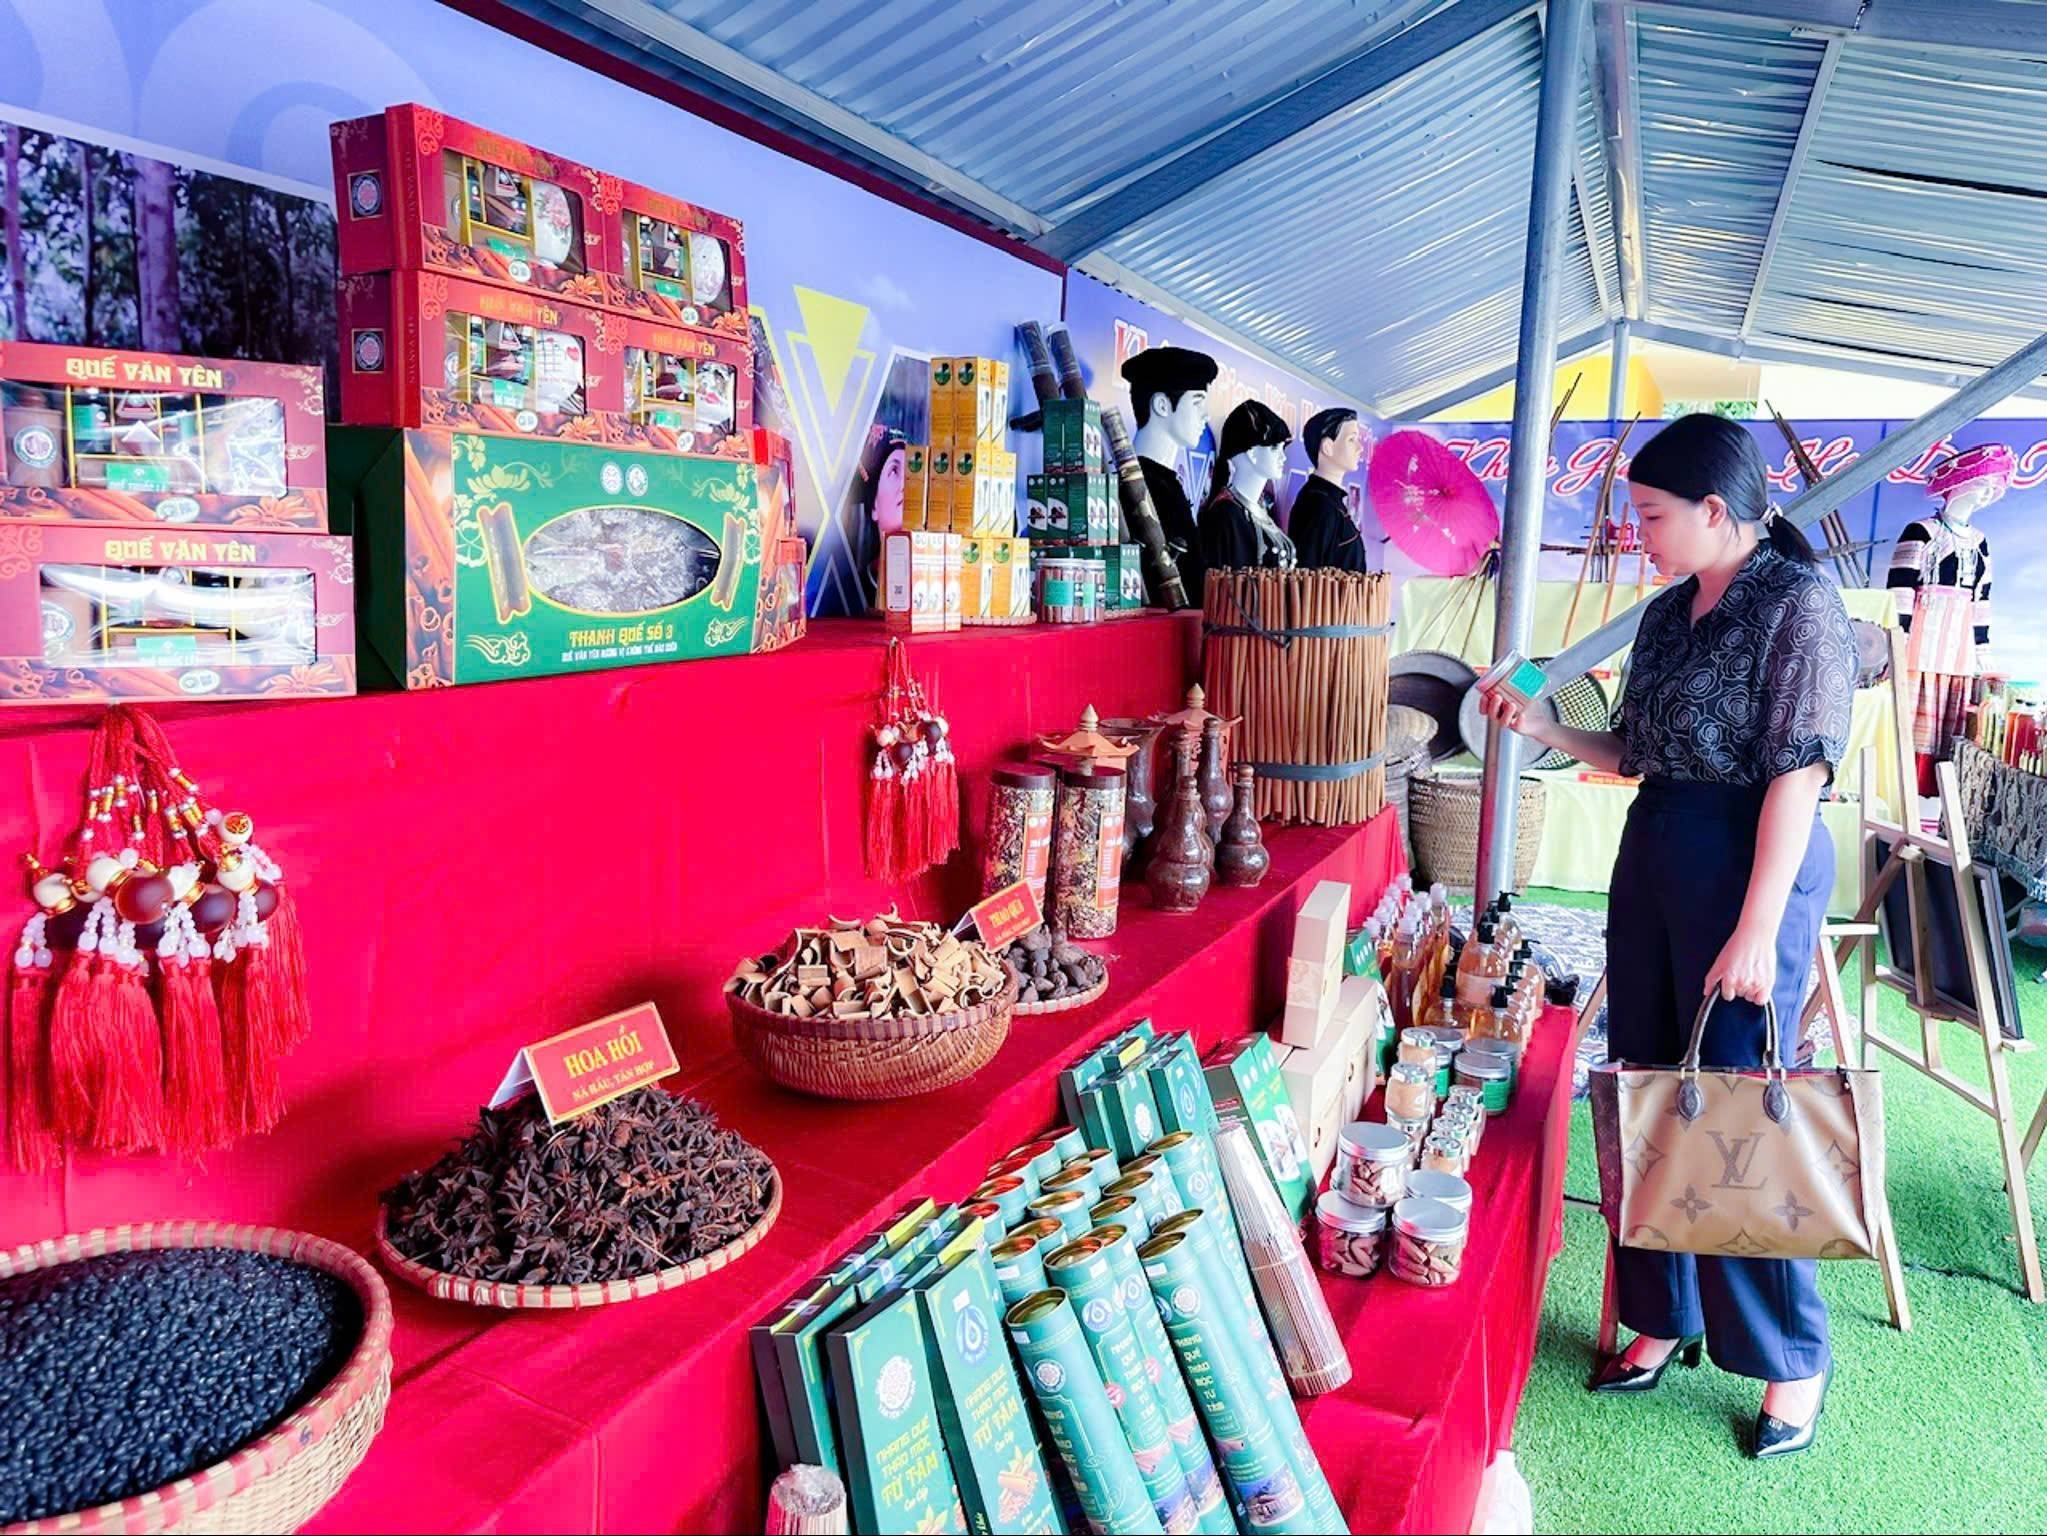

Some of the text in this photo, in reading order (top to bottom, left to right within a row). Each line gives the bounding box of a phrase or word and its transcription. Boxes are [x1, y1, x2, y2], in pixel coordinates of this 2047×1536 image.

[66, 354, 223, 389] QUẾ VĂN YÊN
[104, 535, 257, 562] QUẾ VĂN YÊN
[569, 628, 615, 648] THANH
[618, 620, 646, 646] QUẾ
[646, 619, 665, 641] SỐ
[563, 1047, 608, 1080] HOA
[905, 1449, 939, 1489] TÂM
